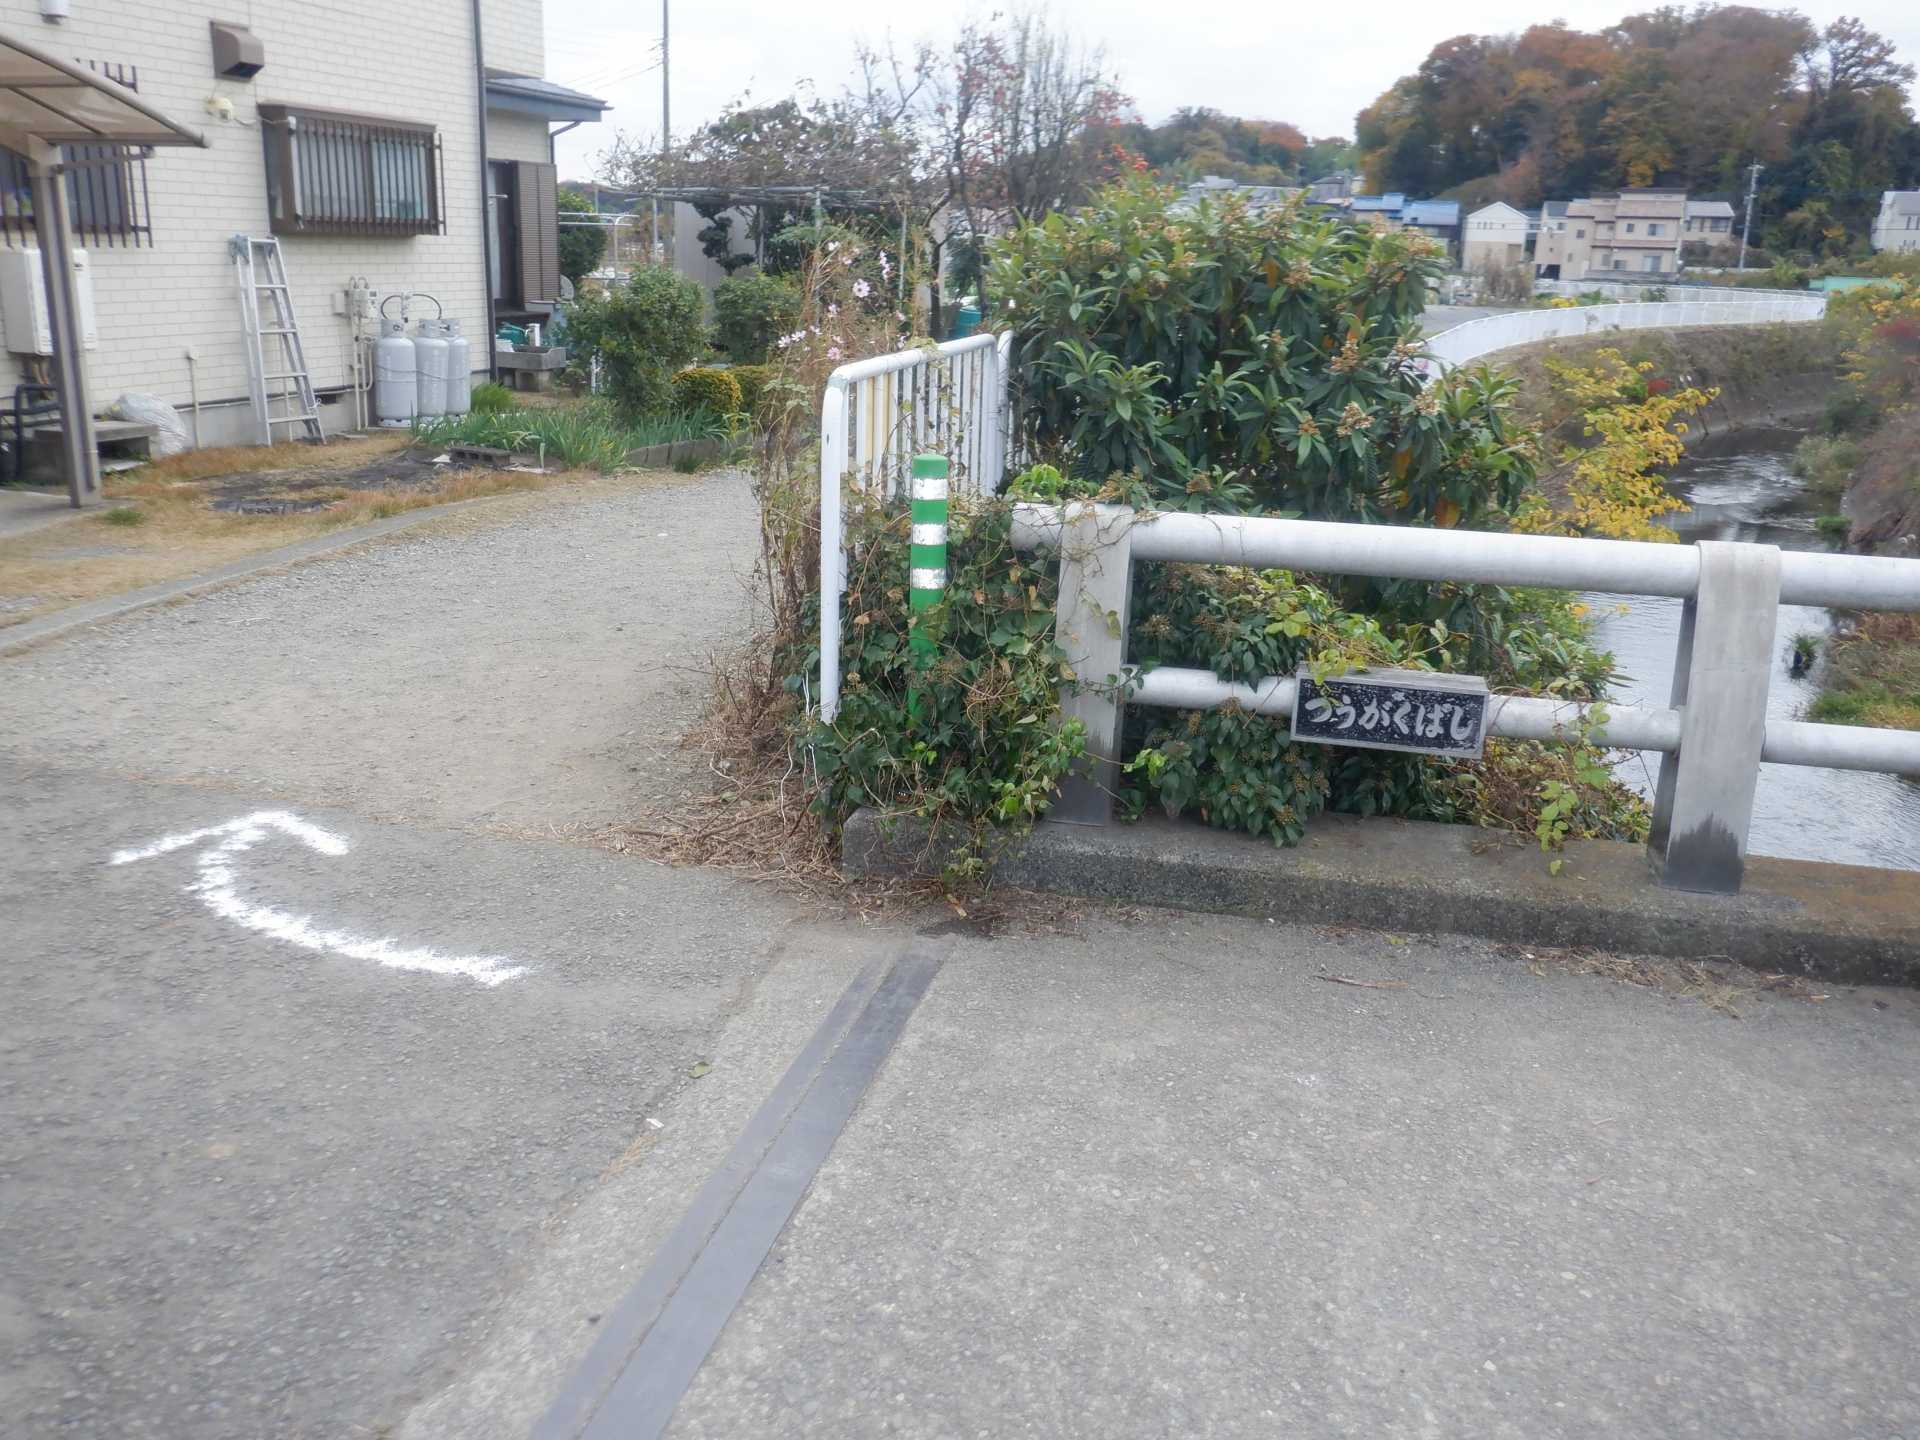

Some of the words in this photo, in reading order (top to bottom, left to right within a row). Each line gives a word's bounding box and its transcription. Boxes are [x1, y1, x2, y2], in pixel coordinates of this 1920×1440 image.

[1304, 694, 1473, 740] つうがくばし
